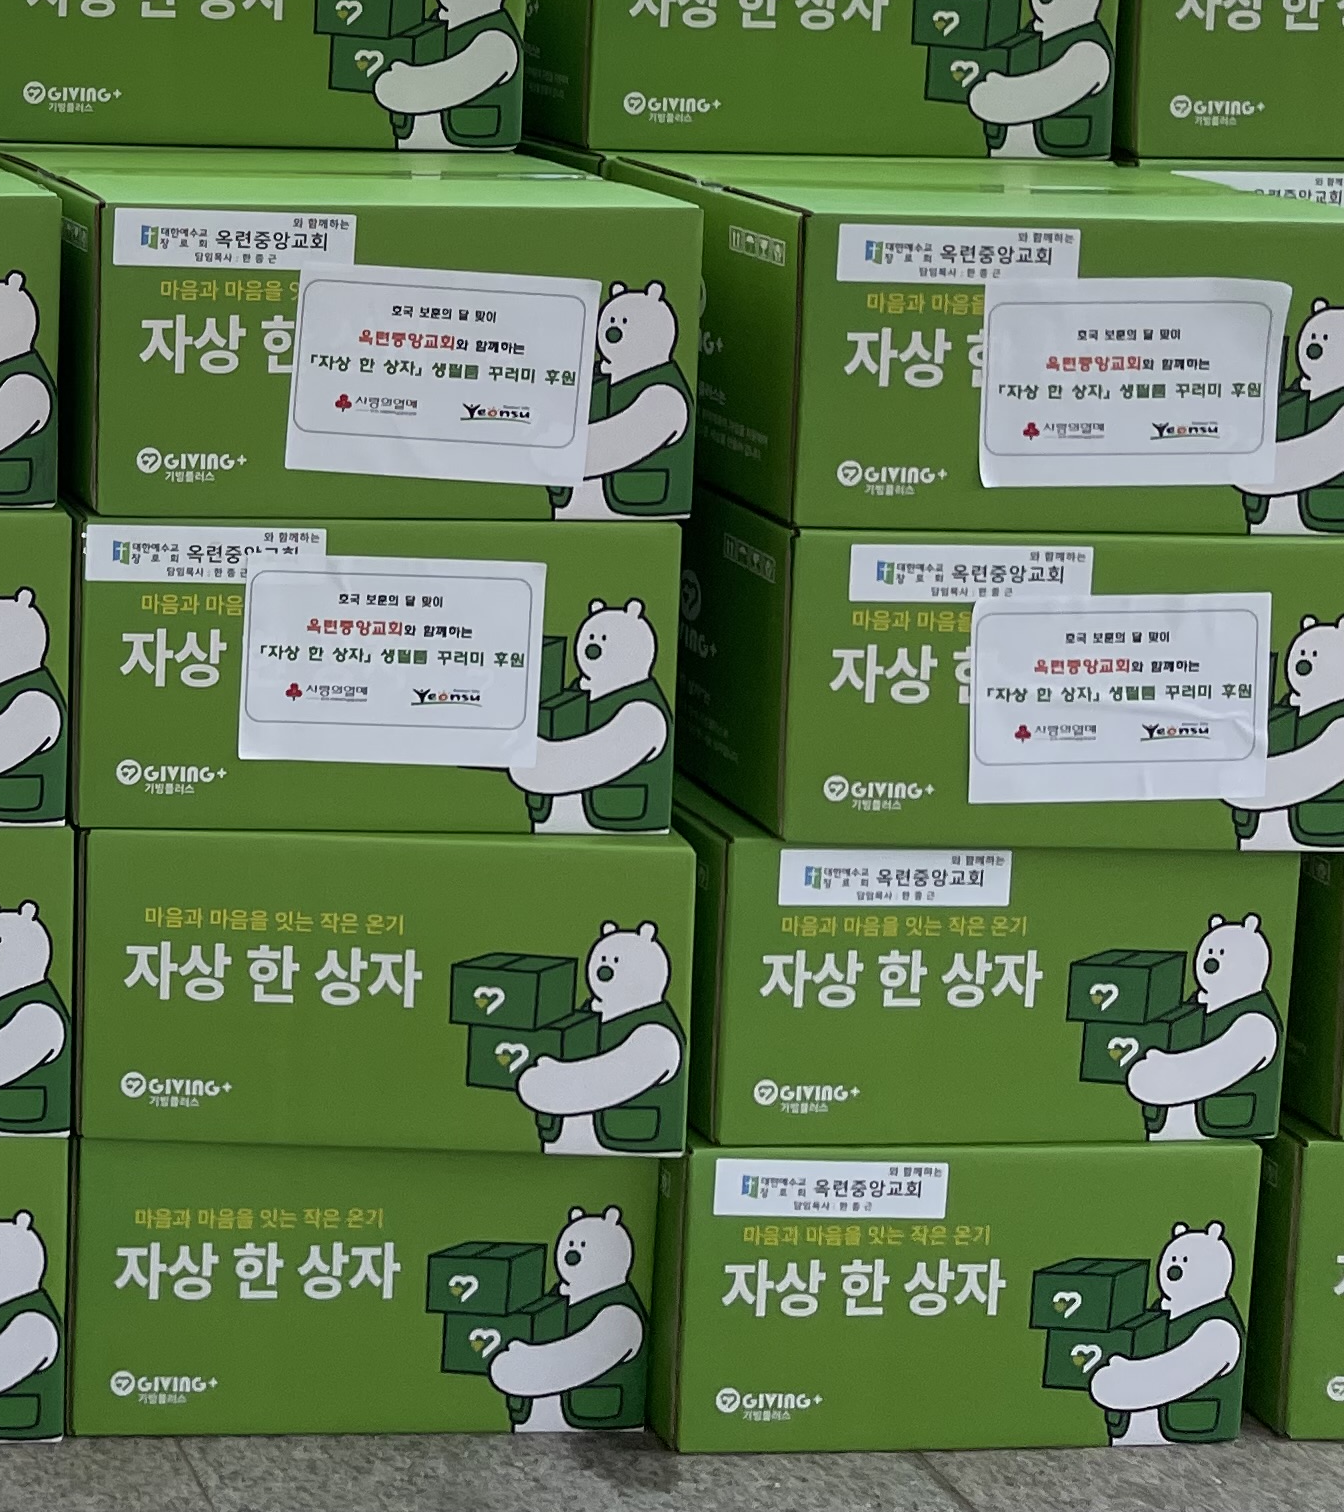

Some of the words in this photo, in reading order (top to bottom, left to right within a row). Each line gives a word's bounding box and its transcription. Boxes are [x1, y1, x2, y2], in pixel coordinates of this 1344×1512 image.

[47, 86, 122, 103] GIVING+
[647, 96, 722, 113] GIVING+
[139, 313, 247, 374] 자상
[843, 326, 953, 389] 자상
[163, 453, 247, 471] GIVING+
[863, 466, 948, 484] GIVING+
[119, 627, 228, 688] 자상
[876, 867, 985, 888] 옥련중앙교회
[123, 940, 233, 1002] 자상
[246, 944, 301, 1004] 한
[314, 946, 423, 1009] 상자
[759, 949, 865, 1009] 자상
[877, 949, 928, 1008] 한
[941, 949, 1044, 1009] 상자
[113, 1241, 220, 1301] 자상
[233, 1241, 285, 1300] 한
[297, 1241, 402, 1300] 상자
[721, 1258, 827, 1318] 자상
[840, 1258, 891, 1317] 한
[903, 1258, 1007, 1317] 상자
[742, 1393, 823, 1410] GIVING+
